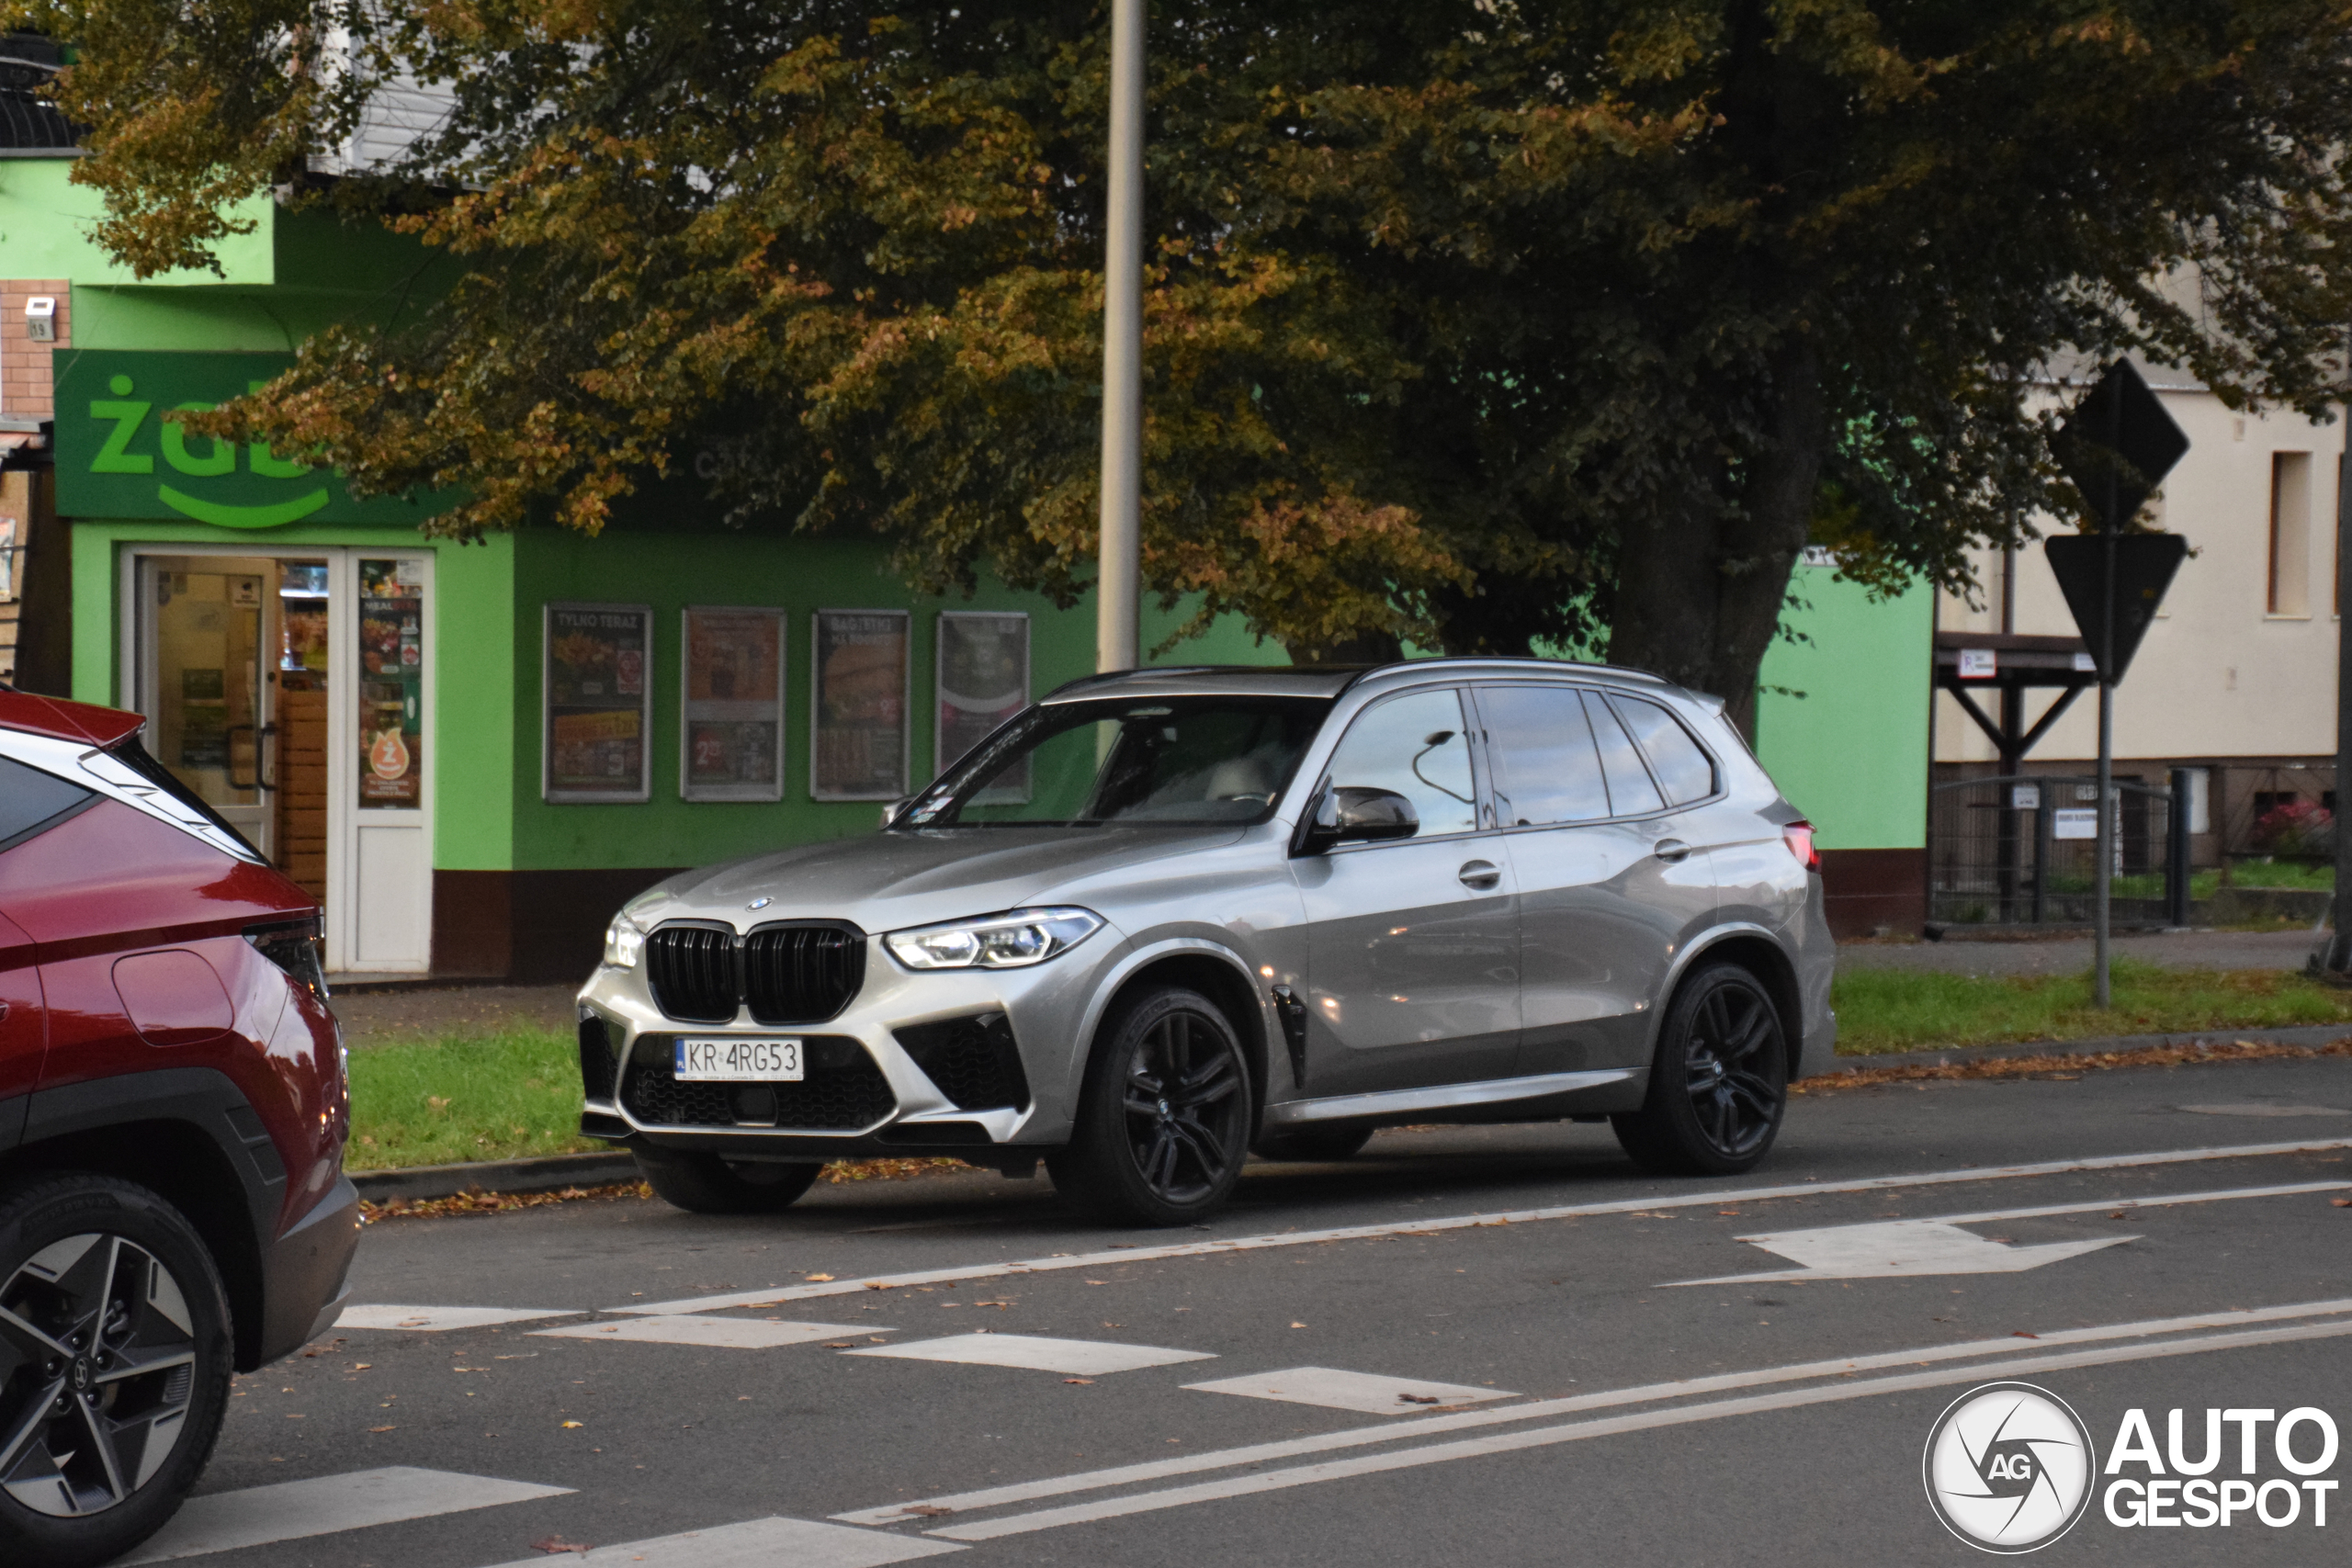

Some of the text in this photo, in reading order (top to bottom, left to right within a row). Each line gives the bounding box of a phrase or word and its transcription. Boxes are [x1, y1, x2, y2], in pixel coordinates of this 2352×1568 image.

[559, 613, 638, 628] TYLKO TERAZ
[689, 1043, 797, 1071] KR 4RG53
[677, 1061, 685, 1069] PL
